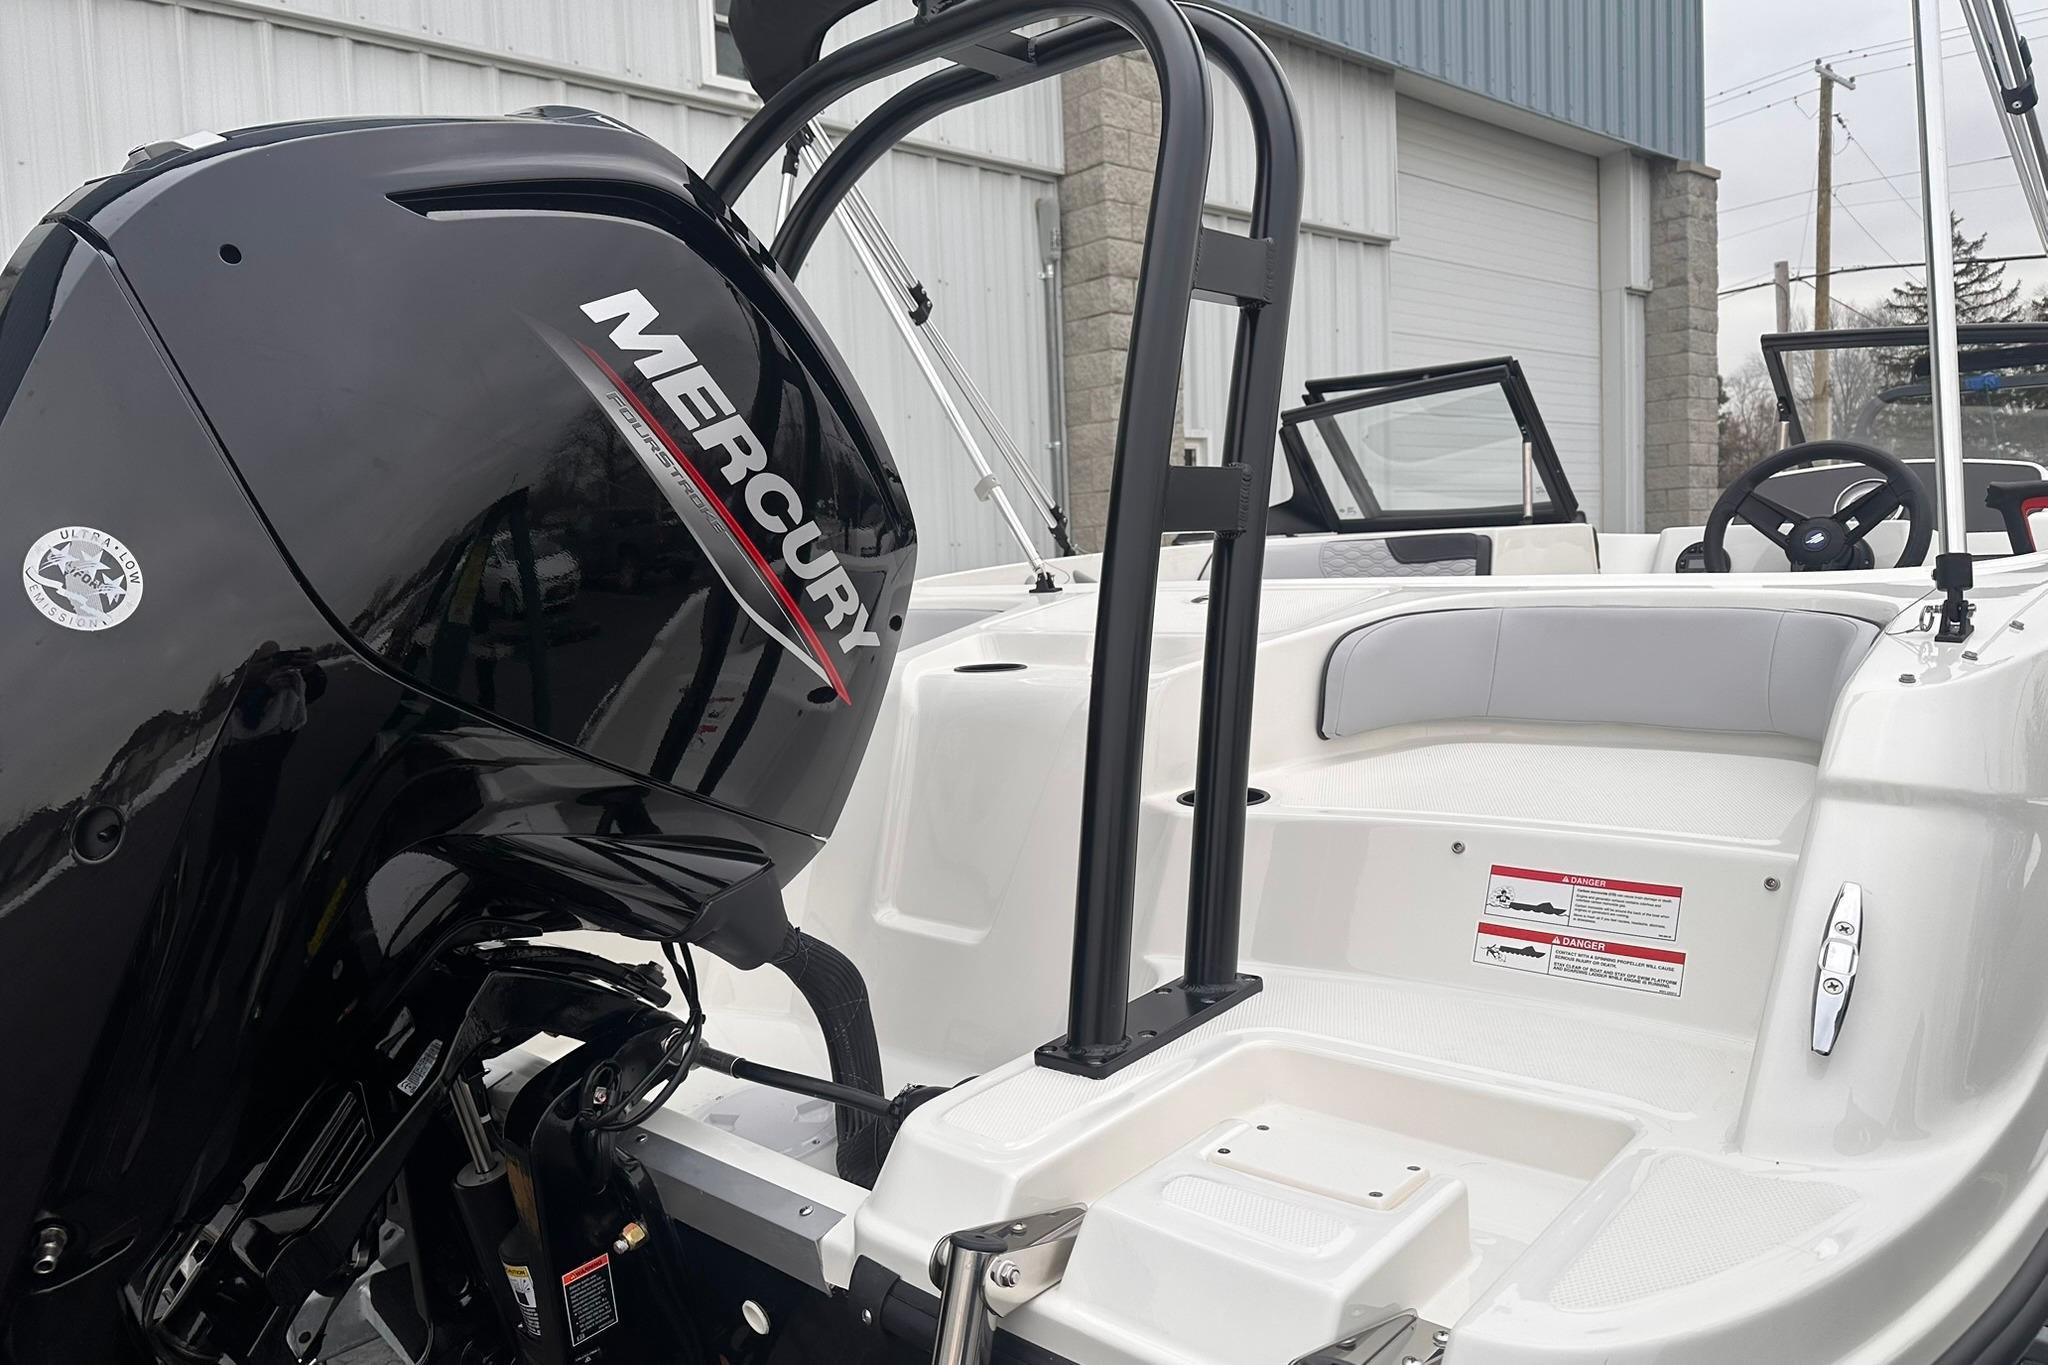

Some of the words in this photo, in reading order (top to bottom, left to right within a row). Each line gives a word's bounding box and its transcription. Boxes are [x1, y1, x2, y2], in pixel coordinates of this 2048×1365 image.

[579, 288, 881, 653] MERCURY
[606, 390, 727, 535] FOURSTROKE
[60, 529, 112, 547] ULTRA
[119, 552, 140, 584] LOW
[29, 584, 98, 628] EMISSION
[1571, 876, 1606, 888] DANGER
[1562, 937, 1606, 951] DANGER
[1554, 954, 1575, 962] SERIOUS
[1555, 949, 1577, 957] CONTACT
[1594, 955, 1616, 963] SPINNING
[1617, 959, 1645, 967] PROPELLER
[1563, 967, 1588, 975] BOARDING
[1623, 976, 1641, 984] ENGINE
[1650, 977, 1677, 986] PLATFORM
